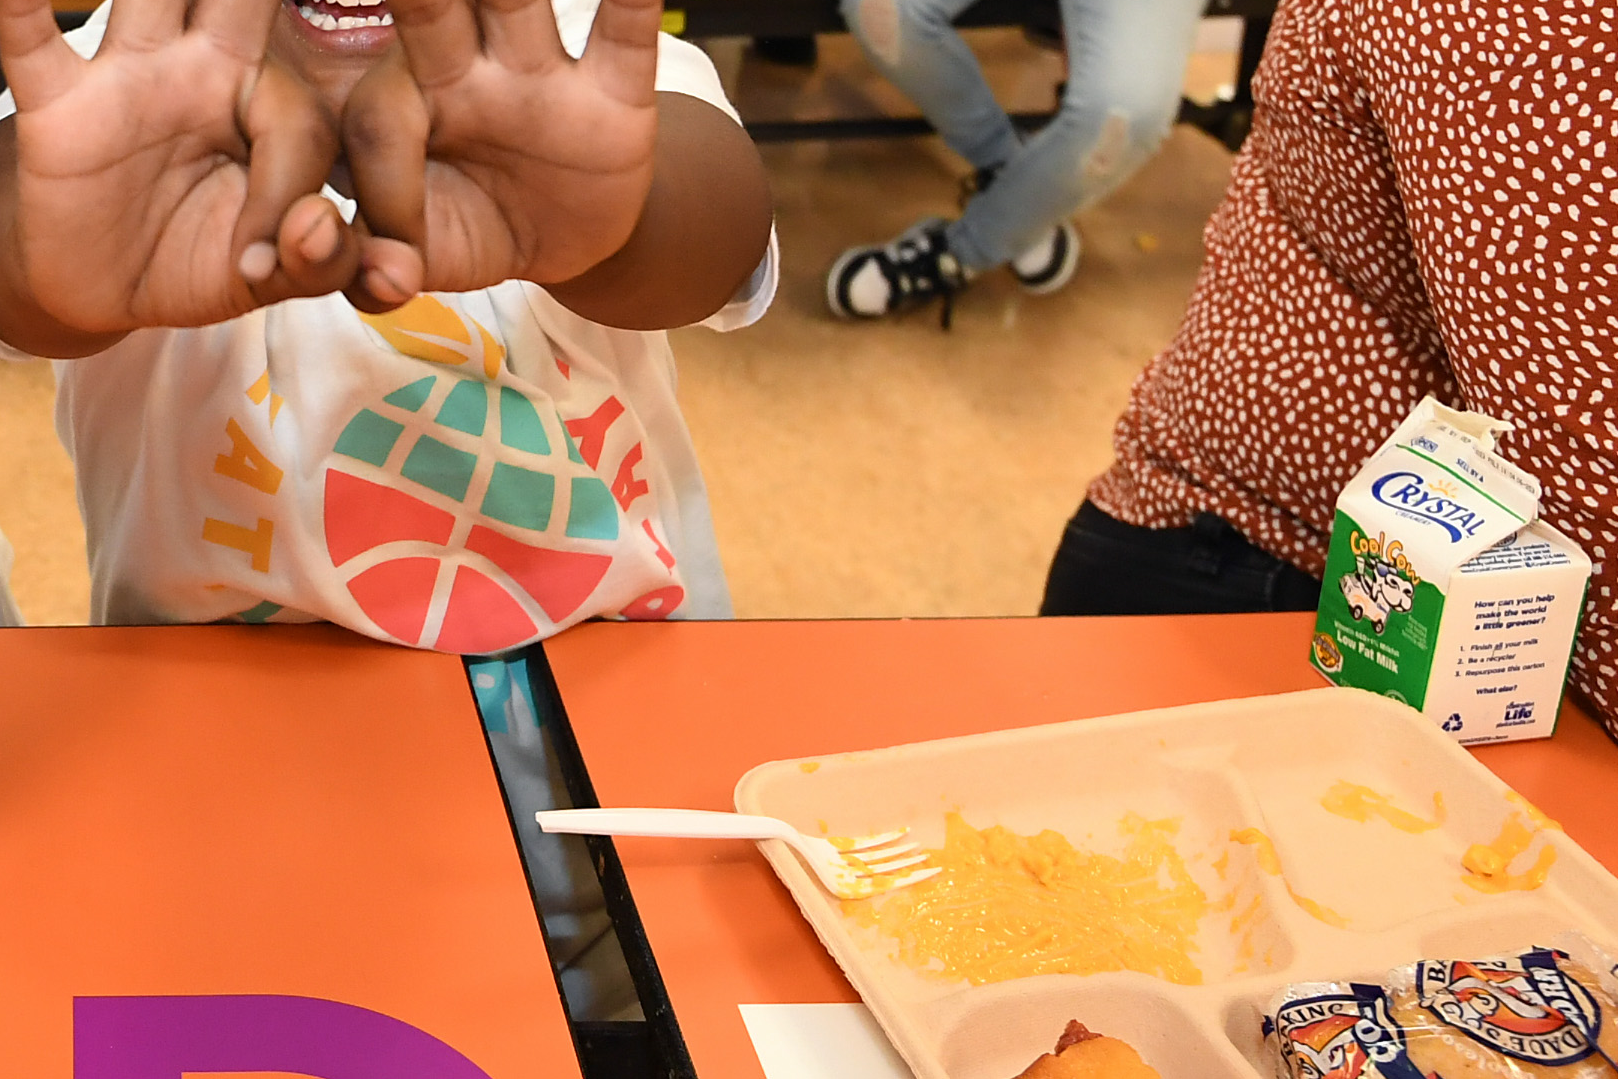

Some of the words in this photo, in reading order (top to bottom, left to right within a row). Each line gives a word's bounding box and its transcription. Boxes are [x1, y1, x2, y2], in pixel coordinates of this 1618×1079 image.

[1372, 471, 1485, 543] CRYSTAL
[1386, 540, 1422, 585] Cow
[1474, 601, 1496, 609] How
[1498, 599, 1514, 607] can
[1516, 597, 1533, 606] you
[1535, 594, 1555, 604] help
[1476, 611, 1501, 620] make
[1504, 609, 1518, 617] the
[1521, 606, 1547, 615] world
[1483, 621, 1503, 630] little
[1506, 617, 1546, 629] greener?
[1337, 629, 1357, 651] Low
[1358, 640, 1375, 662] Fat
[1376, 651, 1399, 675] Milk
[1470, 643, 1493, 652] Finish
[1494, 642, 1503, 650] all
[1505, 641, 1521, 649] your
[1523, 638, 1538, 646] milk
[1486, 654, 1516, 663] recycler
[1465, 668, 1506, 677] Repurpose
[1522, 662, 1546, 670] carton
[1476, 687, 1497, 695] What
[1498, 684, 1518, 693] else?
[1504, 708, 1533, 721] Life
